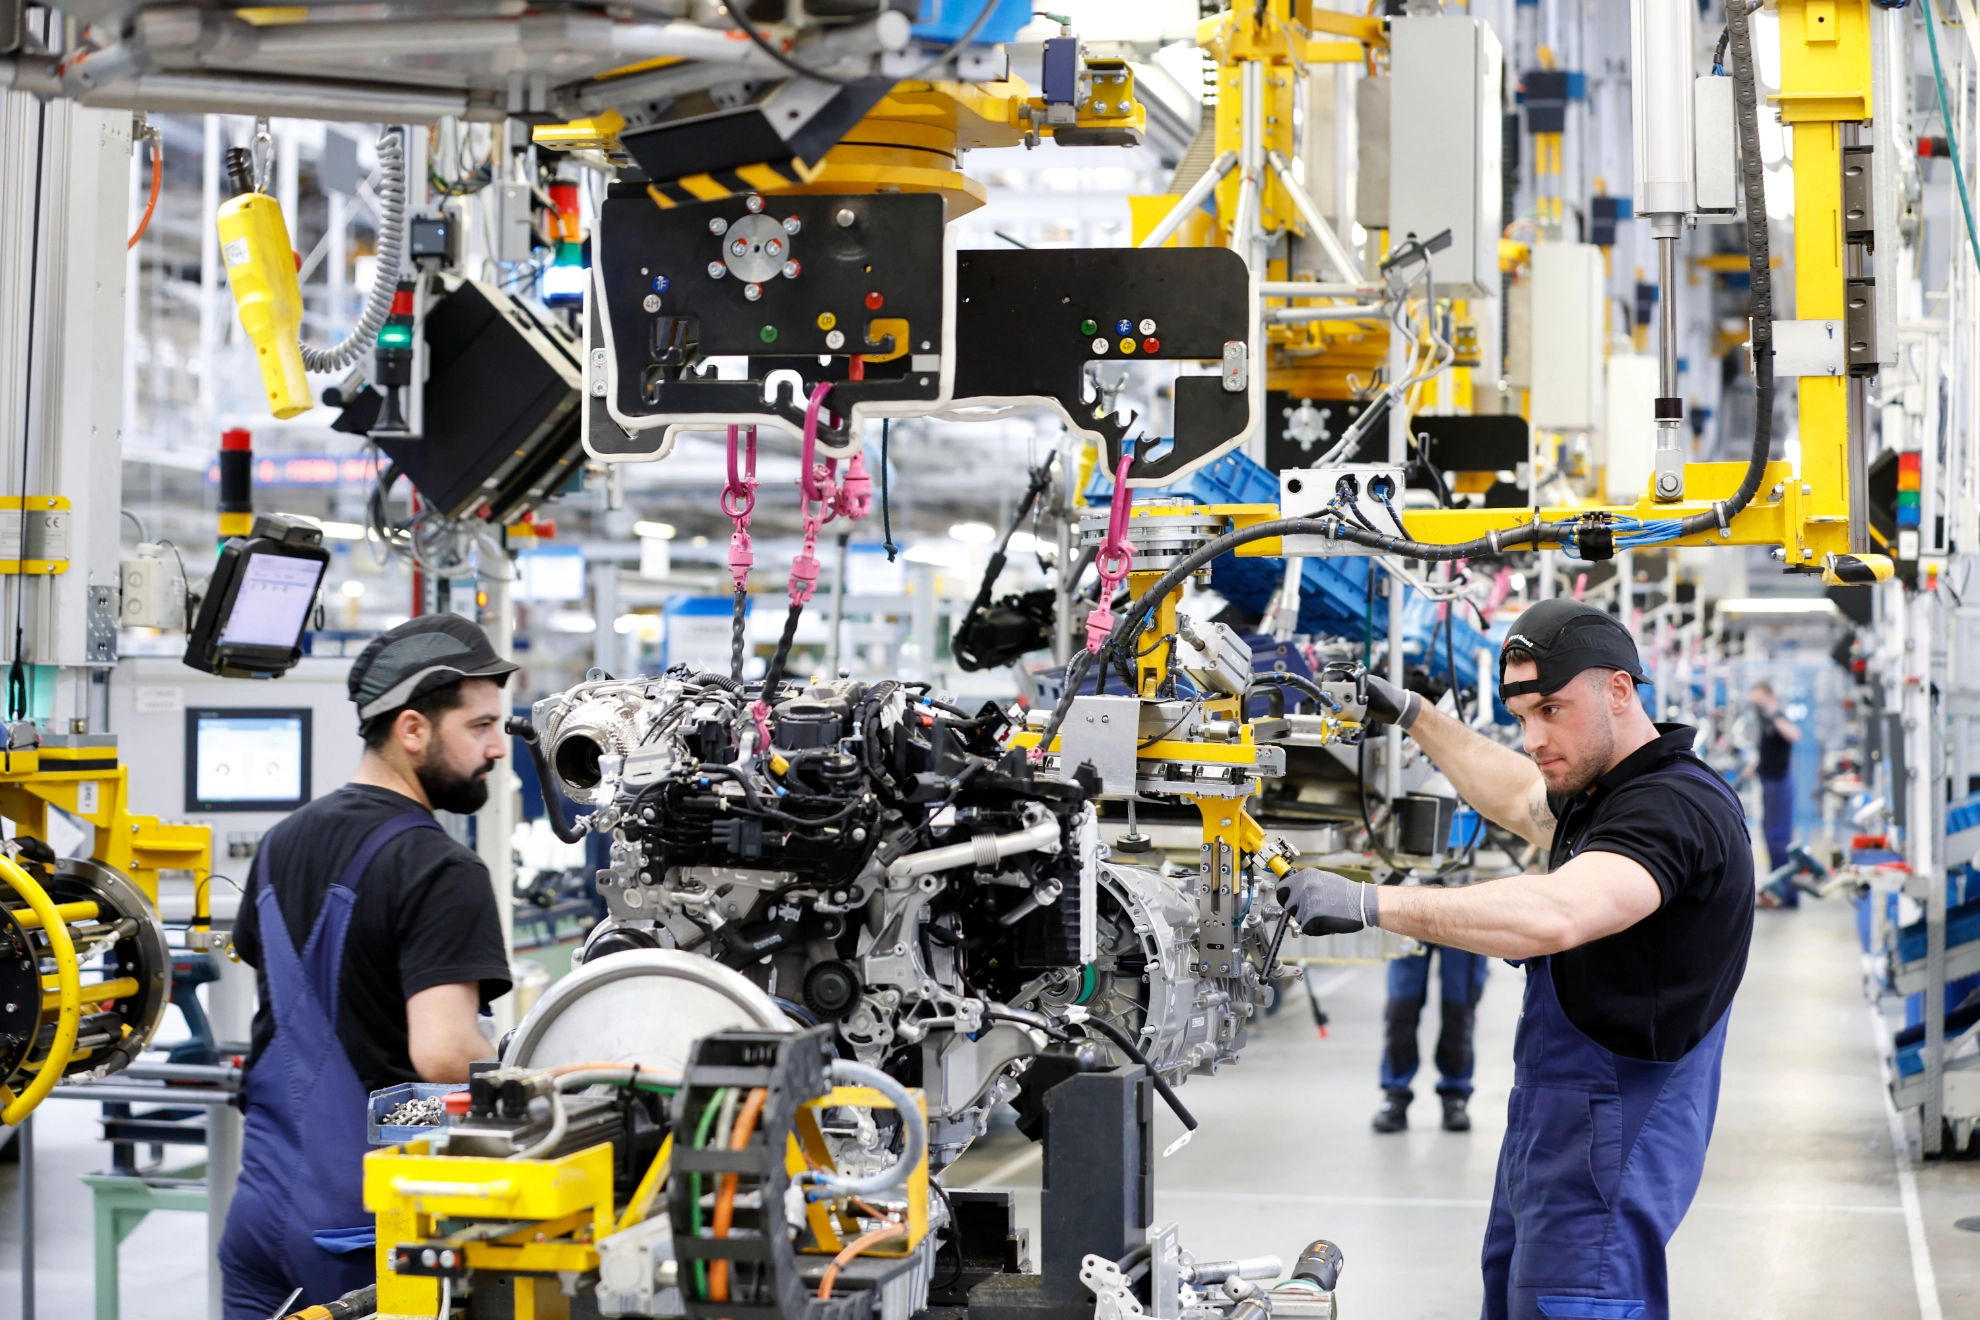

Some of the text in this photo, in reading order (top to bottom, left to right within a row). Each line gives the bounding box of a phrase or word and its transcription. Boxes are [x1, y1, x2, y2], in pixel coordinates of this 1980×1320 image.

[656, 280, 667, 290] 1F
[646, 299, 659, 309] 4M
[1119, 323, 1130, 332] 1F
[45, 517, 60, 528] CE
